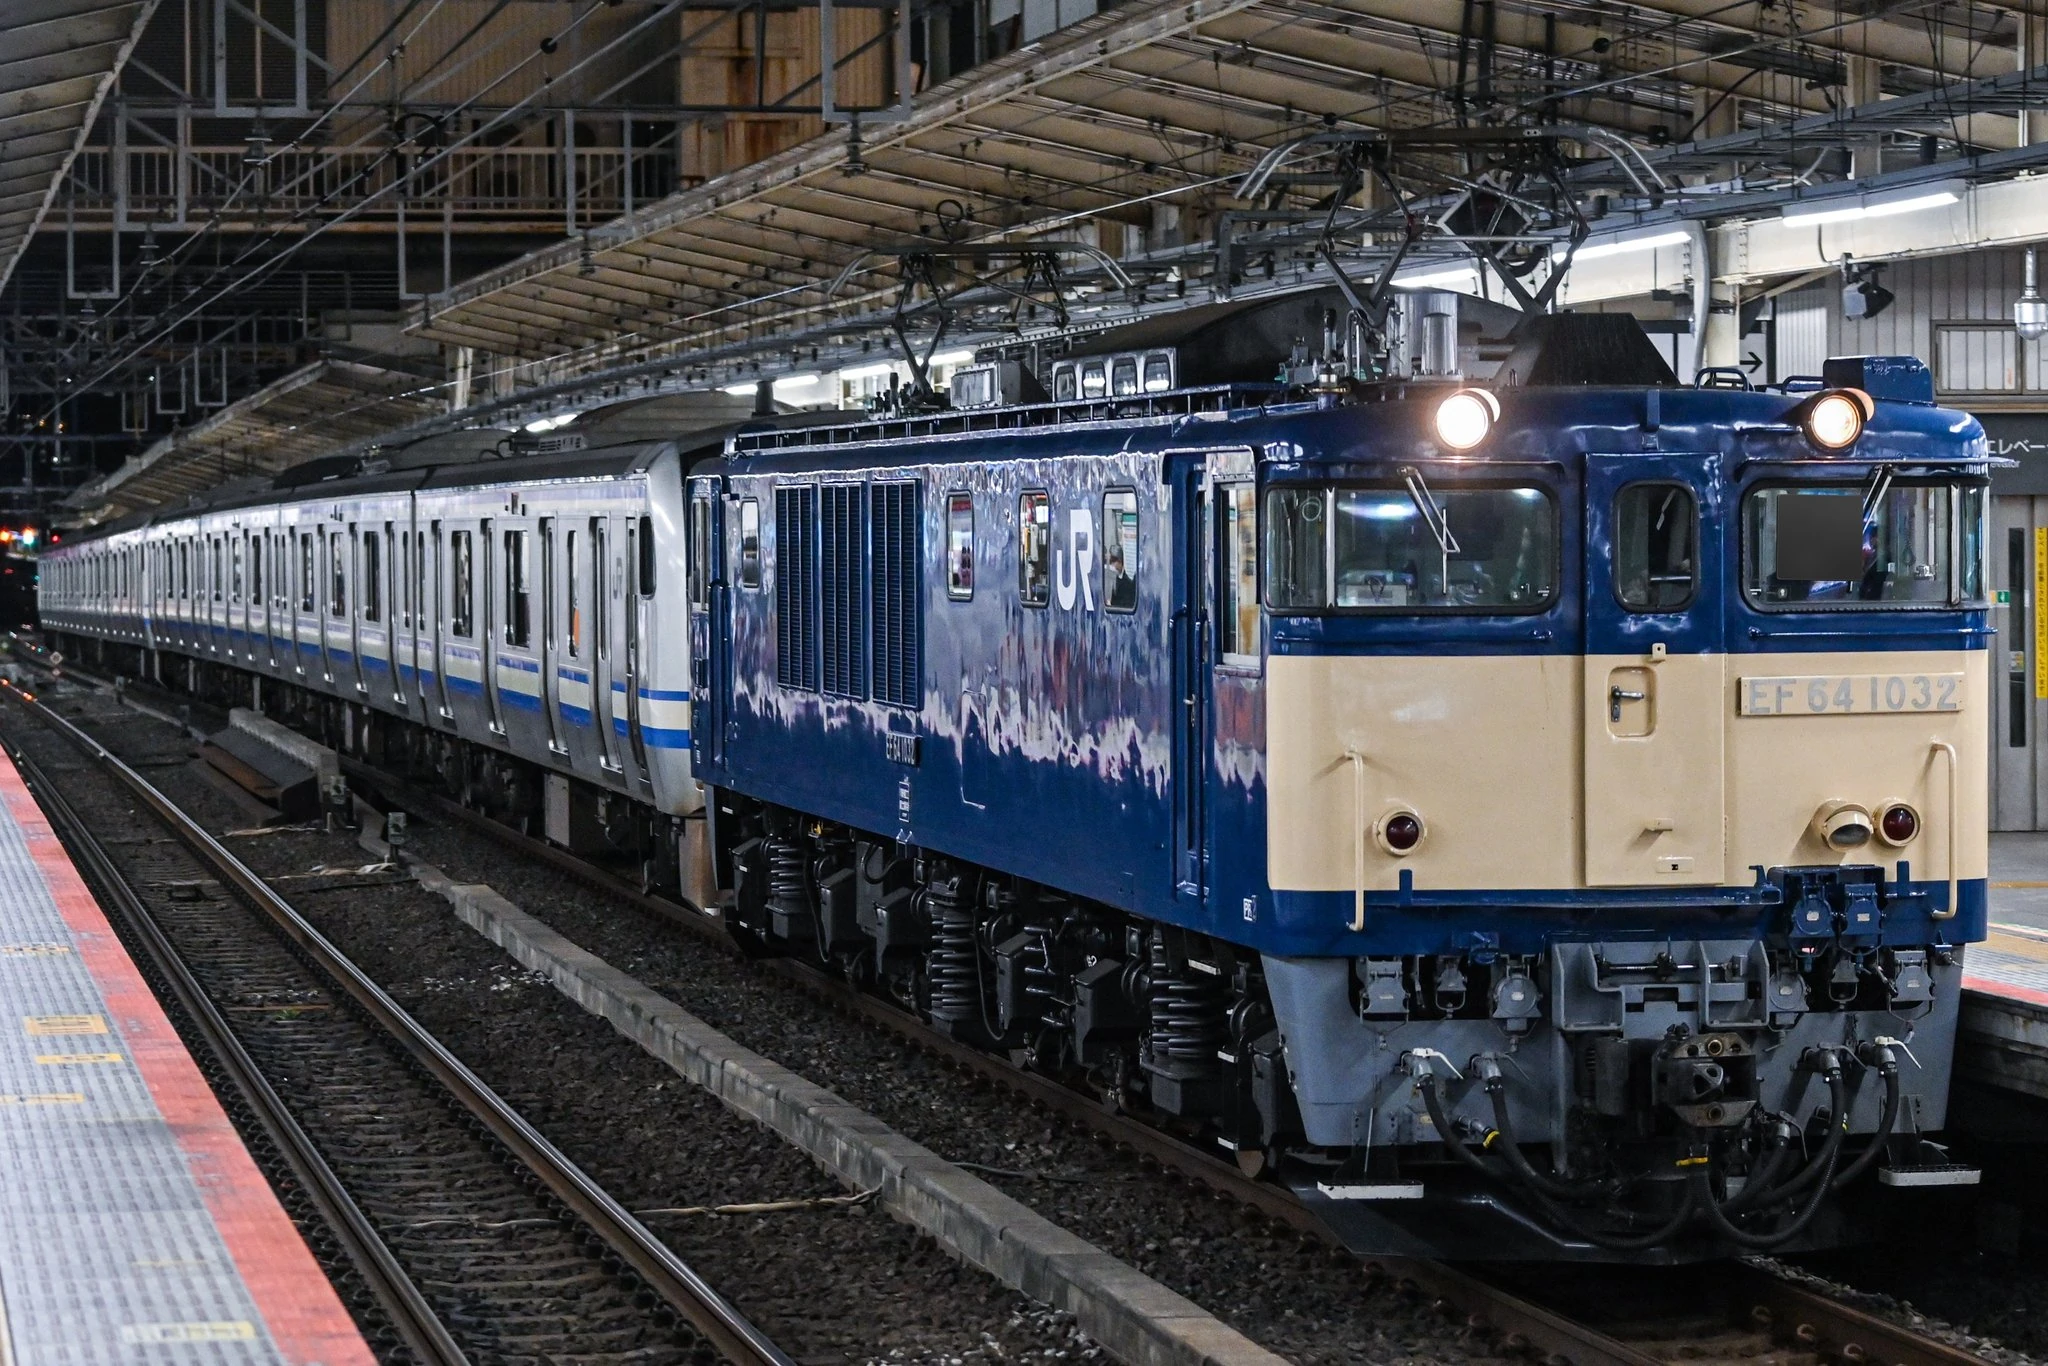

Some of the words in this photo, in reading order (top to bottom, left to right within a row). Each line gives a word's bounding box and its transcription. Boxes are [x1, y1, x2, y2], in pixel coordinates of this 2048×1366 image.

[1987, 438, 2048, 454] エレベー
[612, 557, 623, 600] JR
[1056, 509, 1095, 611] JR
[1749, 678, 1798, 714] EF
[1807, 676, 1854, 713] 64
[1870, 675, 1957, 712] 1032
